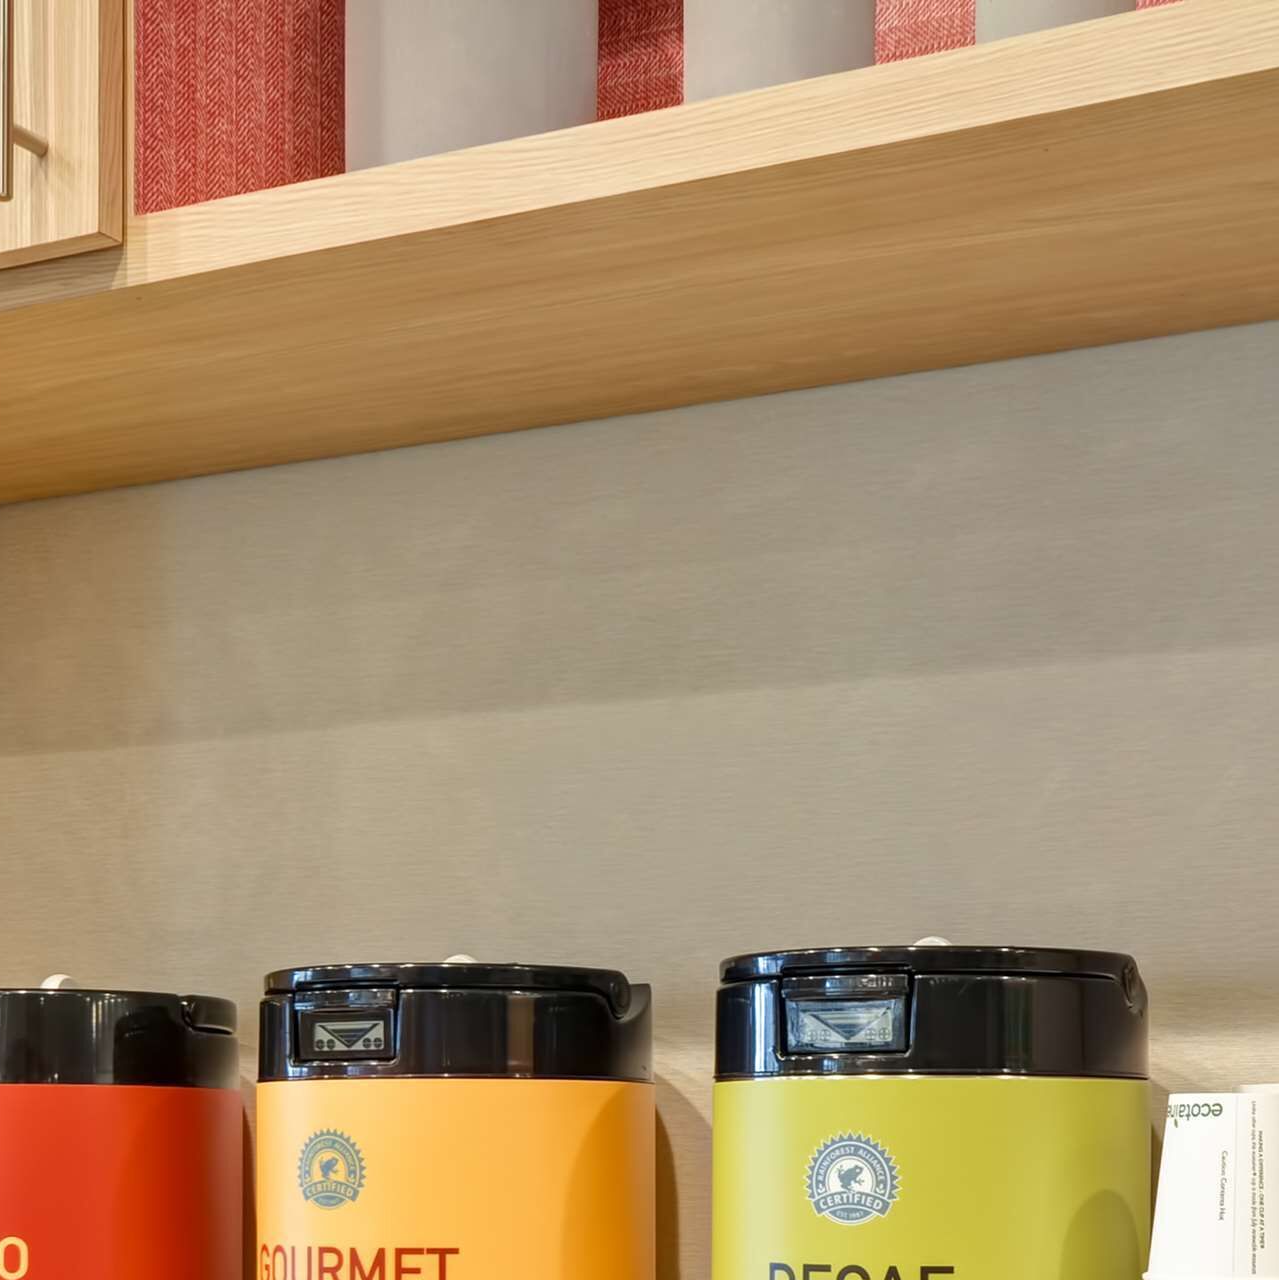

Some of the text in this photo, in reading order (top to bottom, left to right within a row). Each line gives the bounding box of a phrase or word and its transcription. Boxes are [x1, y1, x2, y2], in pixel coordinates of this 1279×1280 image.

[817, 1146, 886, 1181] RAINFOREST ALLIANCE
[819, 1192, 883, 1210] CERTIFIED
